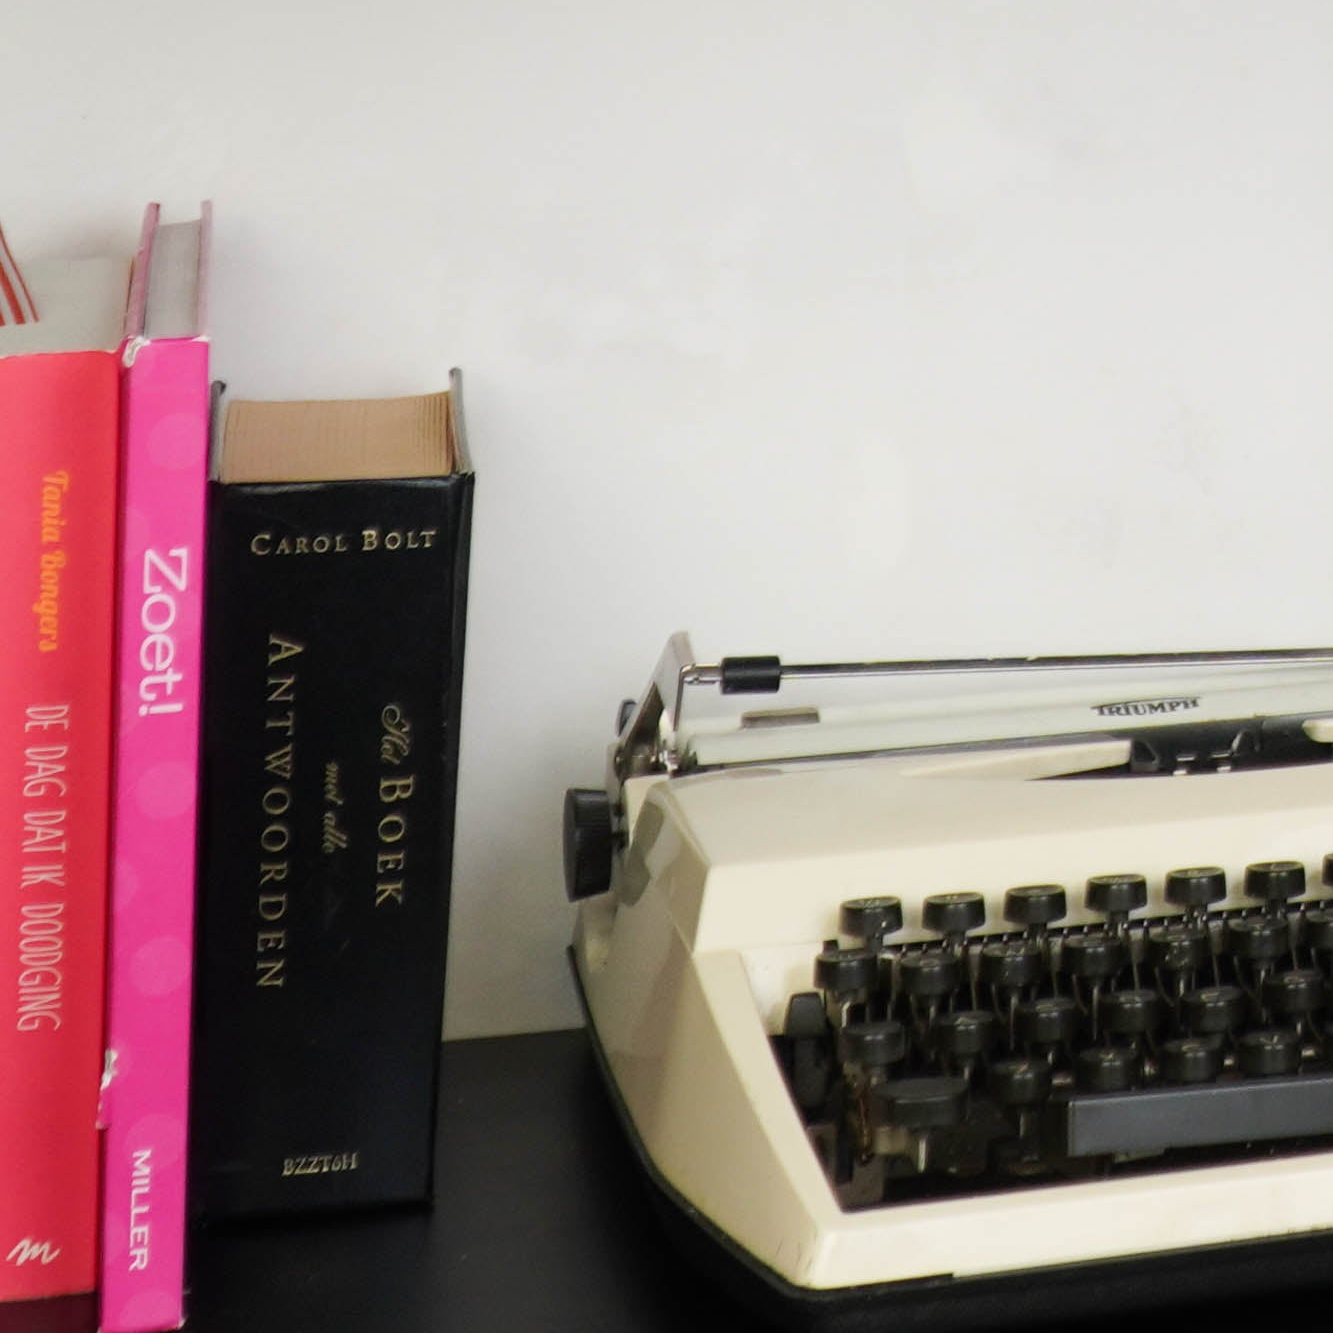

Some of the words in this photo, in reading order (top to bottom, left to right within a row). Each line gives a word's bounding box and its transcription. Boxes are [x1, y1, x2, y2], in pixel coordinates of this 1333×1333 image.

[41, 470, 69, 543] Tania
[361, 529, 436, 551] BOLT
[32, 550, 66, 653] Bongers
[138, 546, 188, 717] Zoet!
[24, 704, 70, 733] DE
[1090, 697, 1201, 716] TRIUMPH
[22, 745, 68, 797] DAG
[22, 809, 67, 853] DAT
[256, 633, 304, 987] ANTWOORDEN
[375, 774, 414, 908] BOEK
[20, 864, 65, 888] IK
[16, 902, 64, 1032] DOODGING
[128, 1149, 152, 1271] MILLER
